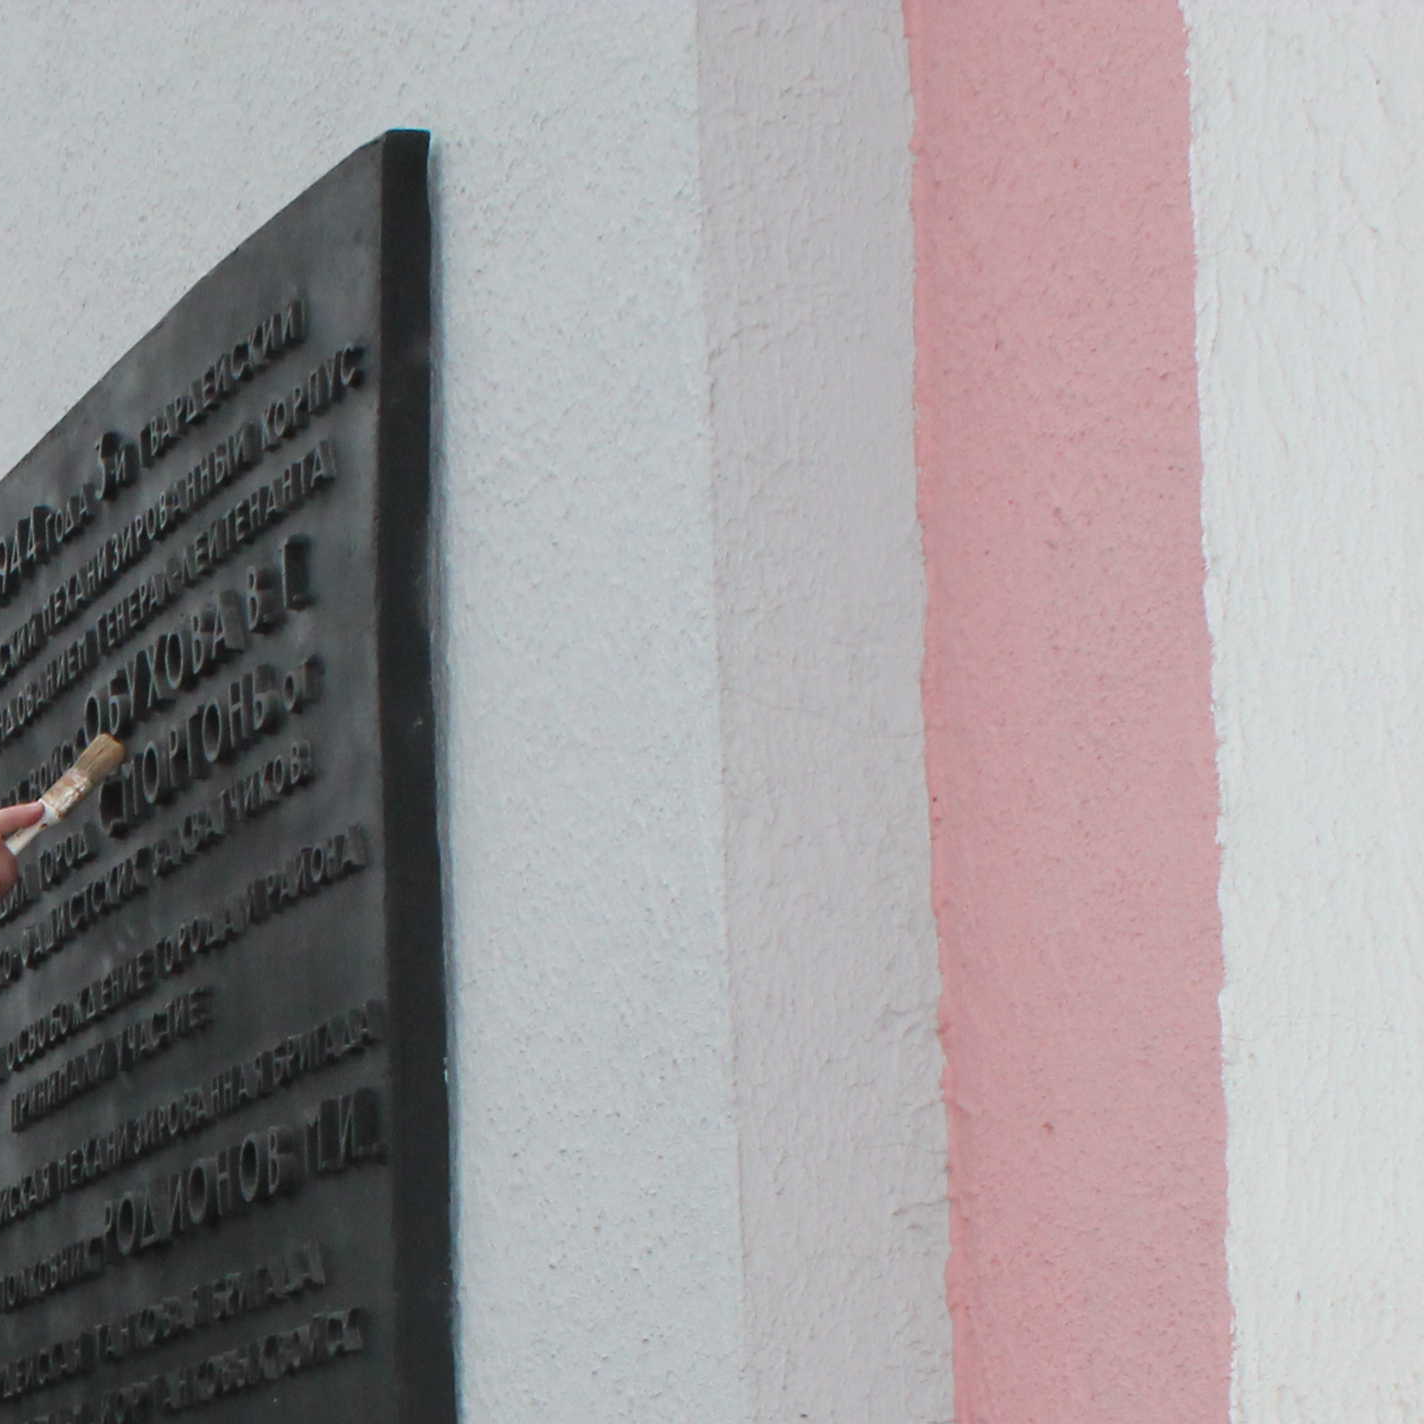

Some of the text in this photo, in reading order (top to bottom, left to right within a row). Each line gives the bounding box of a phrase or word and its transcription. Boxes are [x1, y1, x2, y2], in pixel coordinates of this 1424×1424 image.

[260, 343, 357, 453] КОРПУС
[45, 481, 89, 554] ГОДА
[39, 819, 91, 892] ГОРОД
[98, 657, 267, 841] СМОРГОНЬ
[6, 948, 145, 1073] ОСВОБОЖДЕНИЕ
[104, 1118, 289, 1265] РОДИОНОВ
